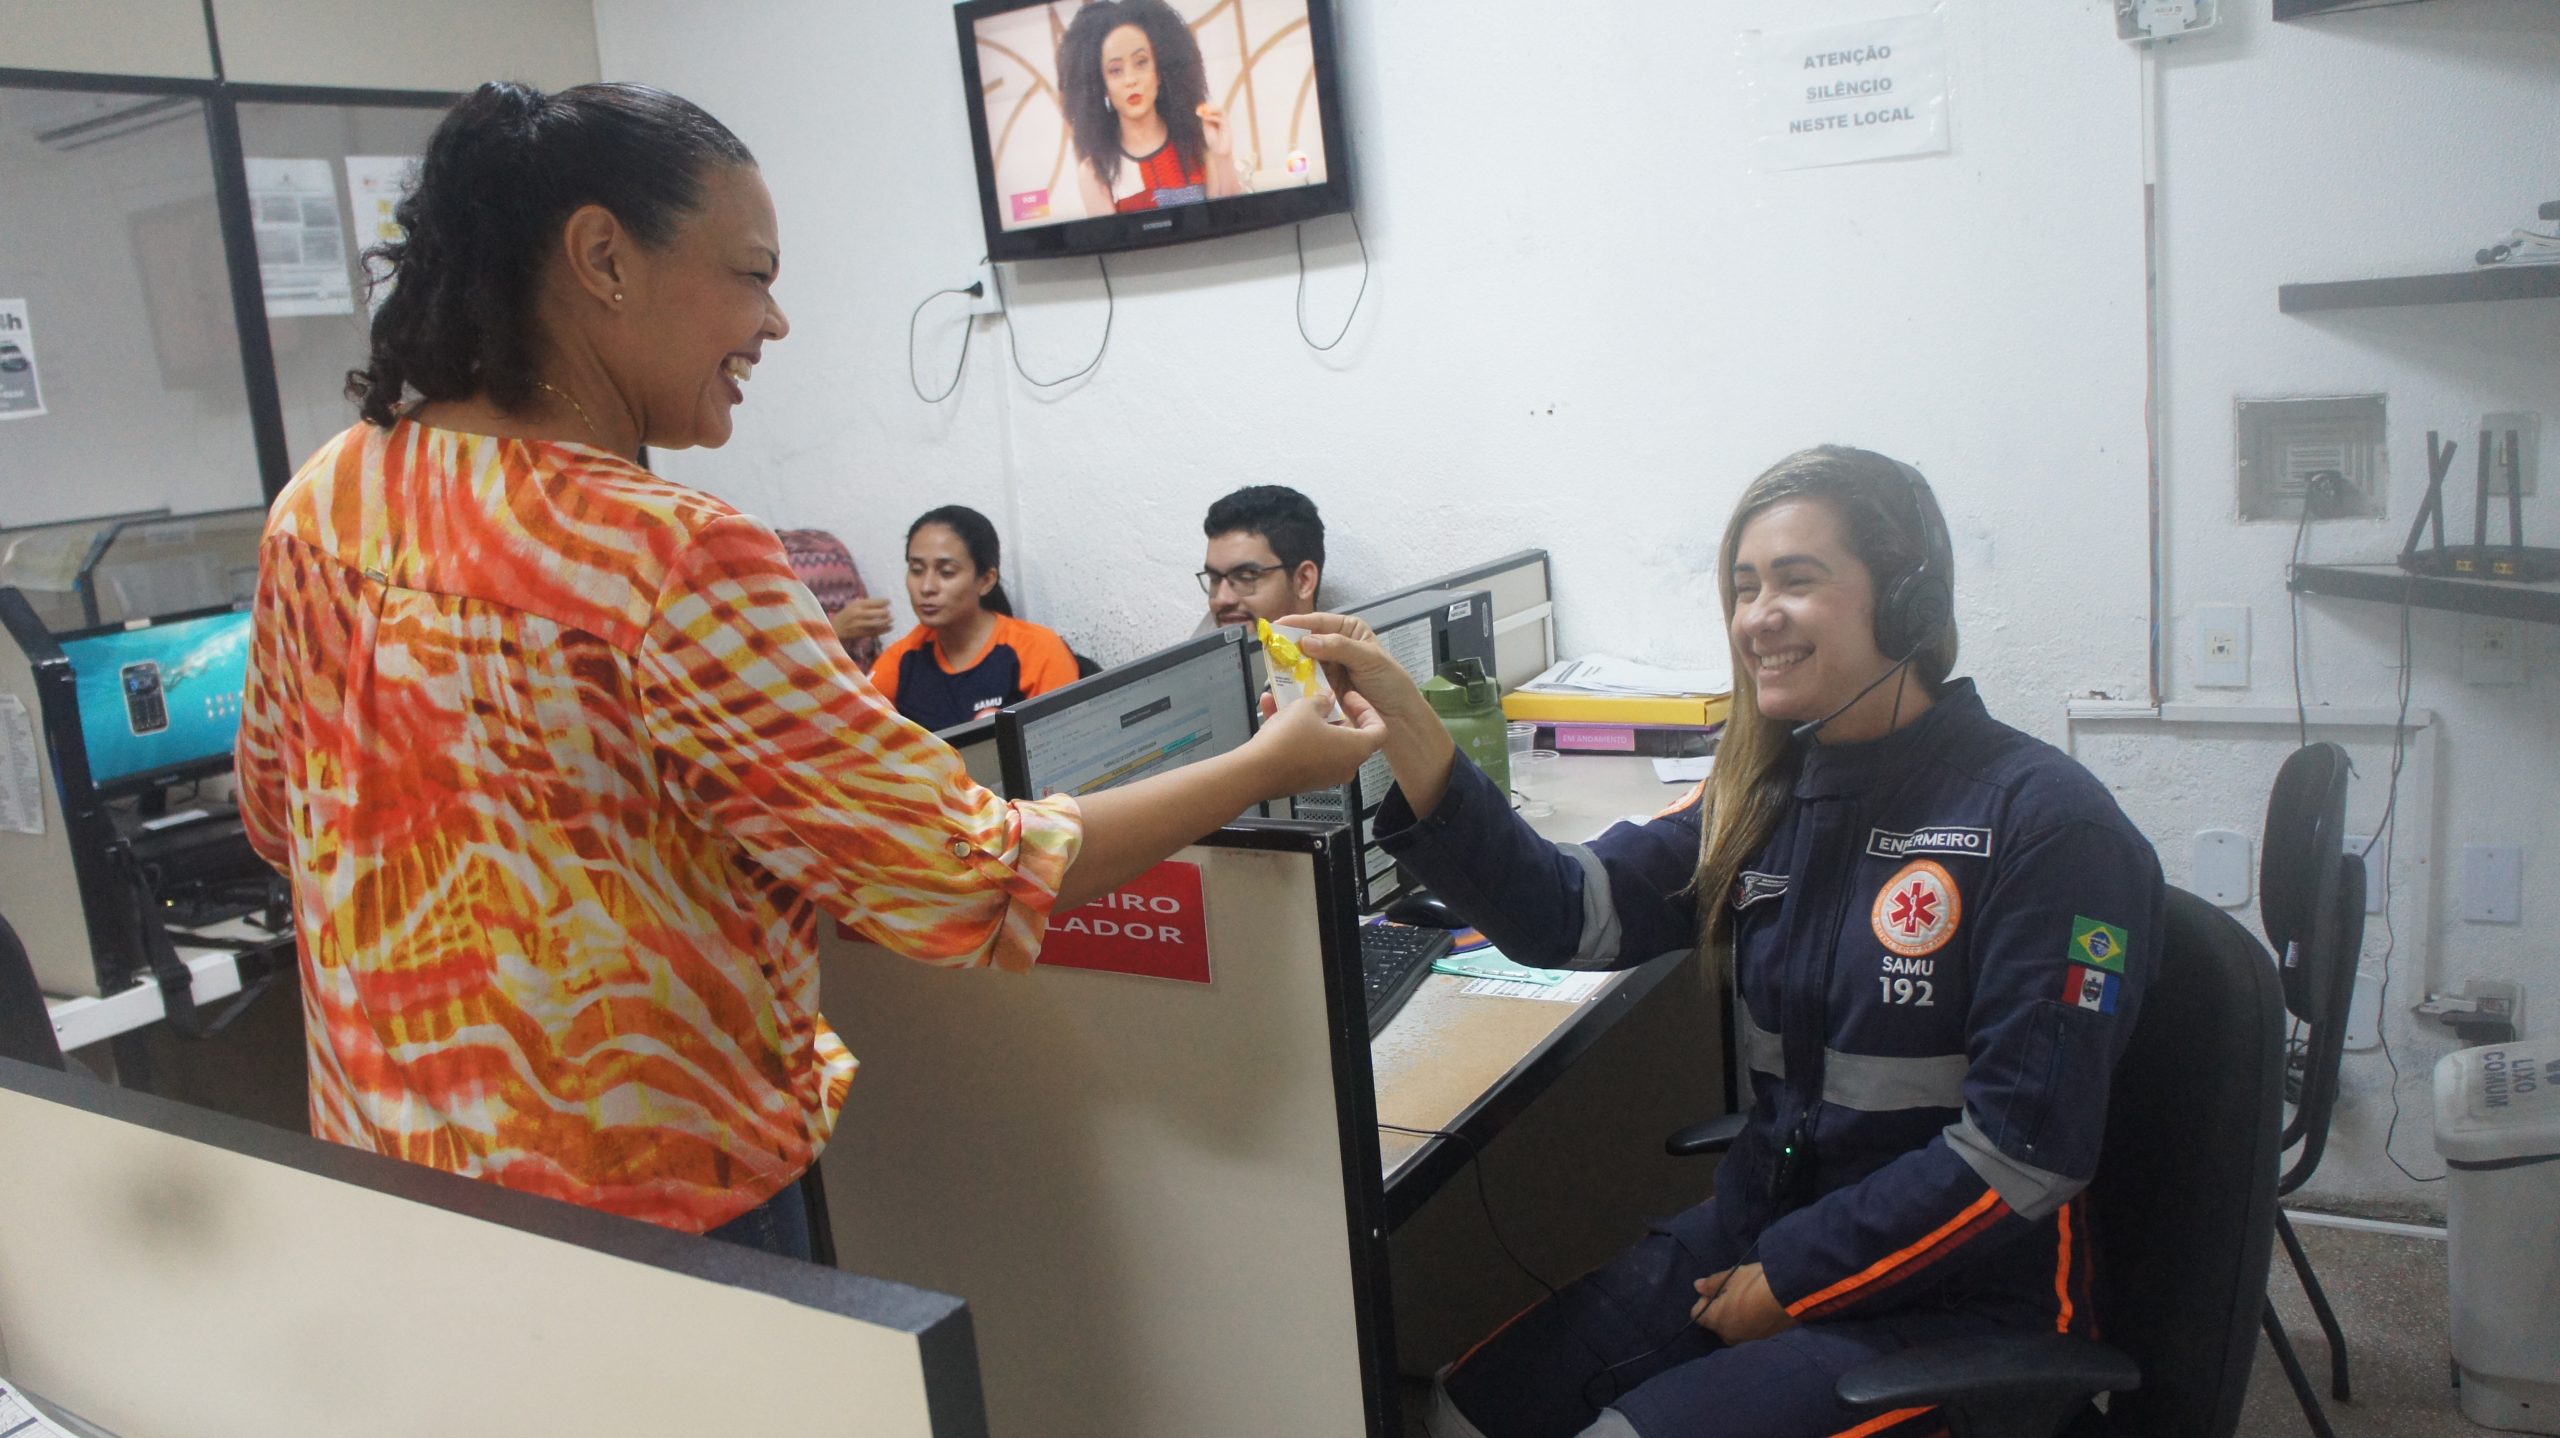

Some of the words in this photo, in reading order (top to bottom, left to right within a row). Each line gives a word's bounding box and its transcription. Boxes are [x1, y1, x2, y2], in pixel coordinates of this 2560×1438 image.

[1803, 45, 1892, 70] ATENÇÃO
[1806, 77, 1893, 101] SILÊNCIO
[1789, 114, 1849, 134] NESTE
[1853, 106, 1915, 127] LOCAL
[973, 696, 1003, 712] SAMU
[1882, 955, 1934, 976] SAMU
[1879, 976, 1935, 1007] 192
[2484, 1051, 2508, 1108] COMUM
[2511, 1058, 2537, 1094] LIXO
